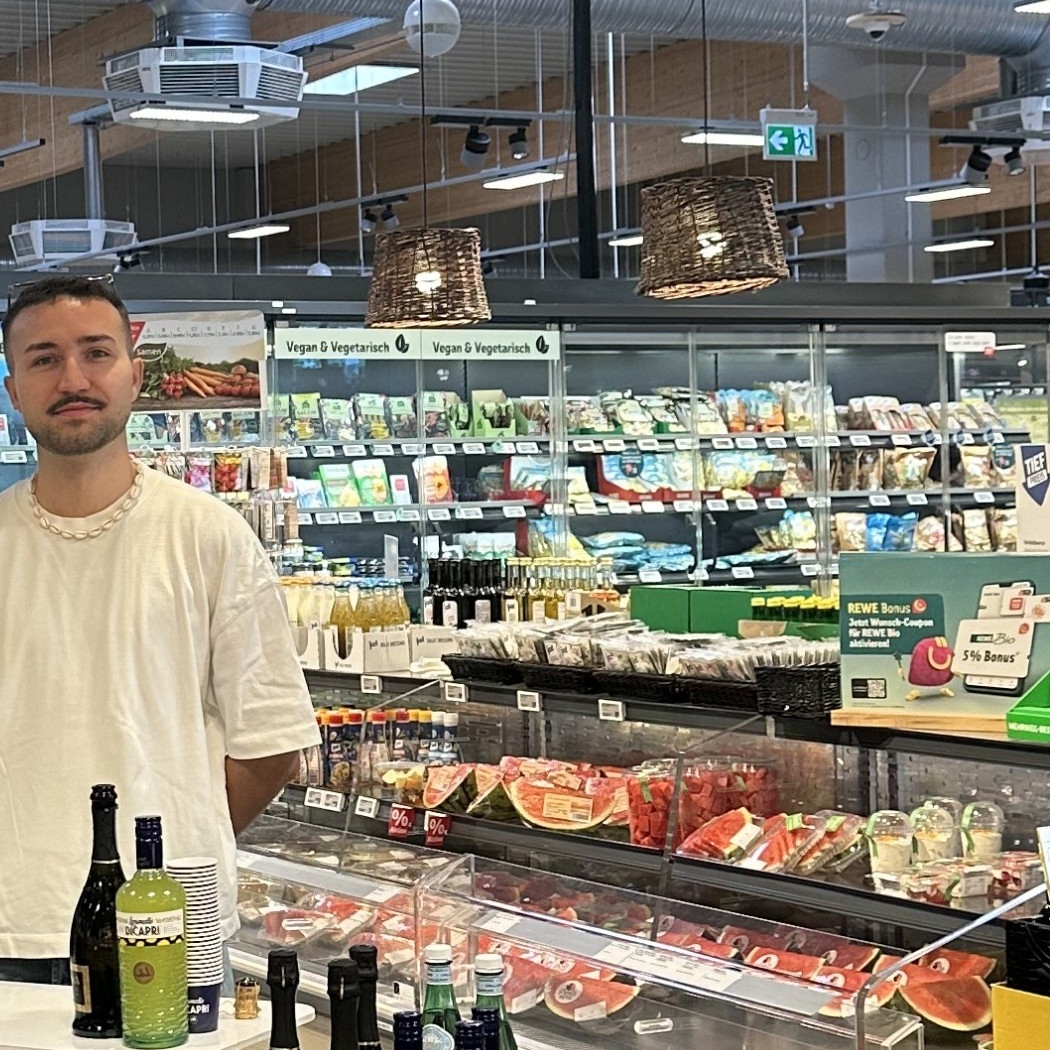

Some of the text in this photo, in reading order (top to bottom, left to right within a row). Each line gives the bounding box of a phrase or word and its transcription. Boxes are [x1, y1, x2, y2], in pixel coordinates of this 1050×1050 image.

[286, 341, 390, 355] Vegan & Vegetarisch
[433, 342, 530, 356] Vegan & Vegetarisch
[1024, 452, 1046, 475] TIEF
[847, 602, 911, 614] REWE Bonus
[870, 618, 934, 629] Wunsch-Coupon
[862, 628, 884, 638] REWE
[888, 628, 900, 638] Bio
[124, 926, 160, 936] DICAPRI
